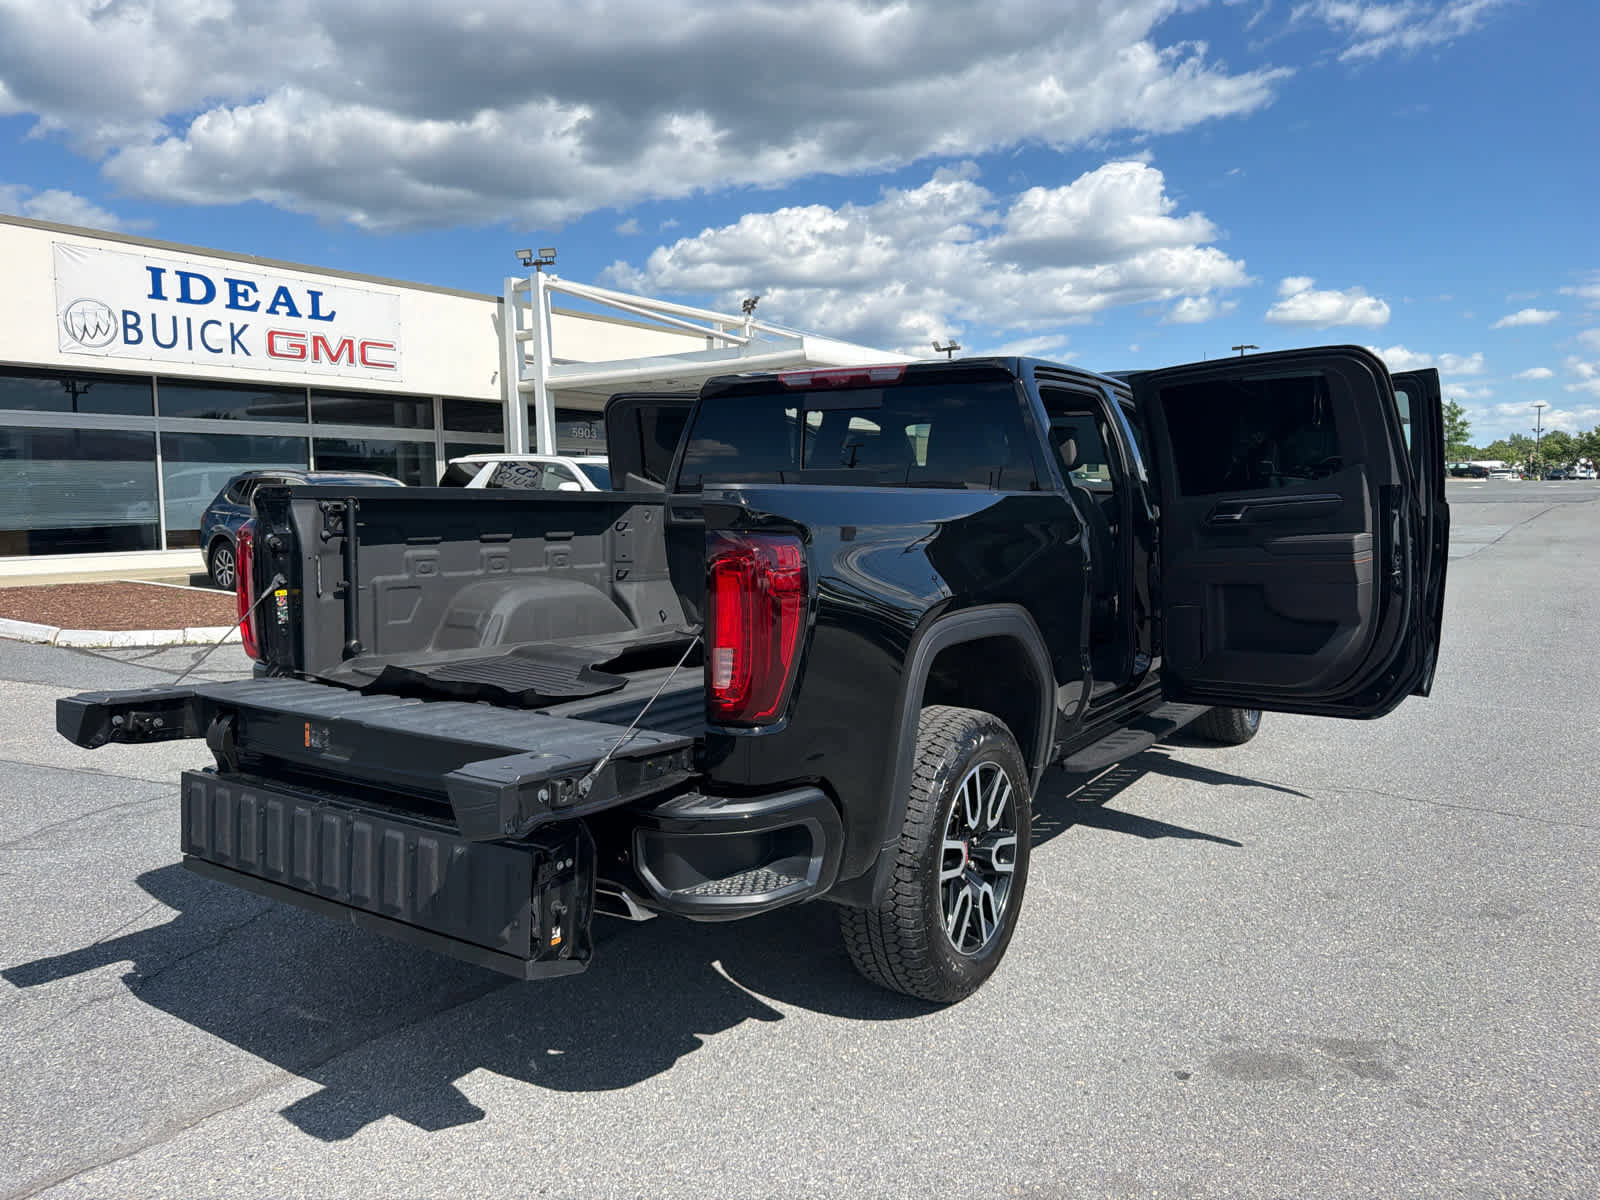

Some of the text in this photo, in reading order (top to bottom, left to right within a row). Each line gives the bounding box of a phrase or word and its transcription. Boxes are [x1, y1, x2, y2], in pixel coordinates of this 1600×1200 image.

[145, 266, 336, 322] IDEAL
[122, 309, 396, 370] BUICK GMC
[571, 427, 597, 438] 5903
